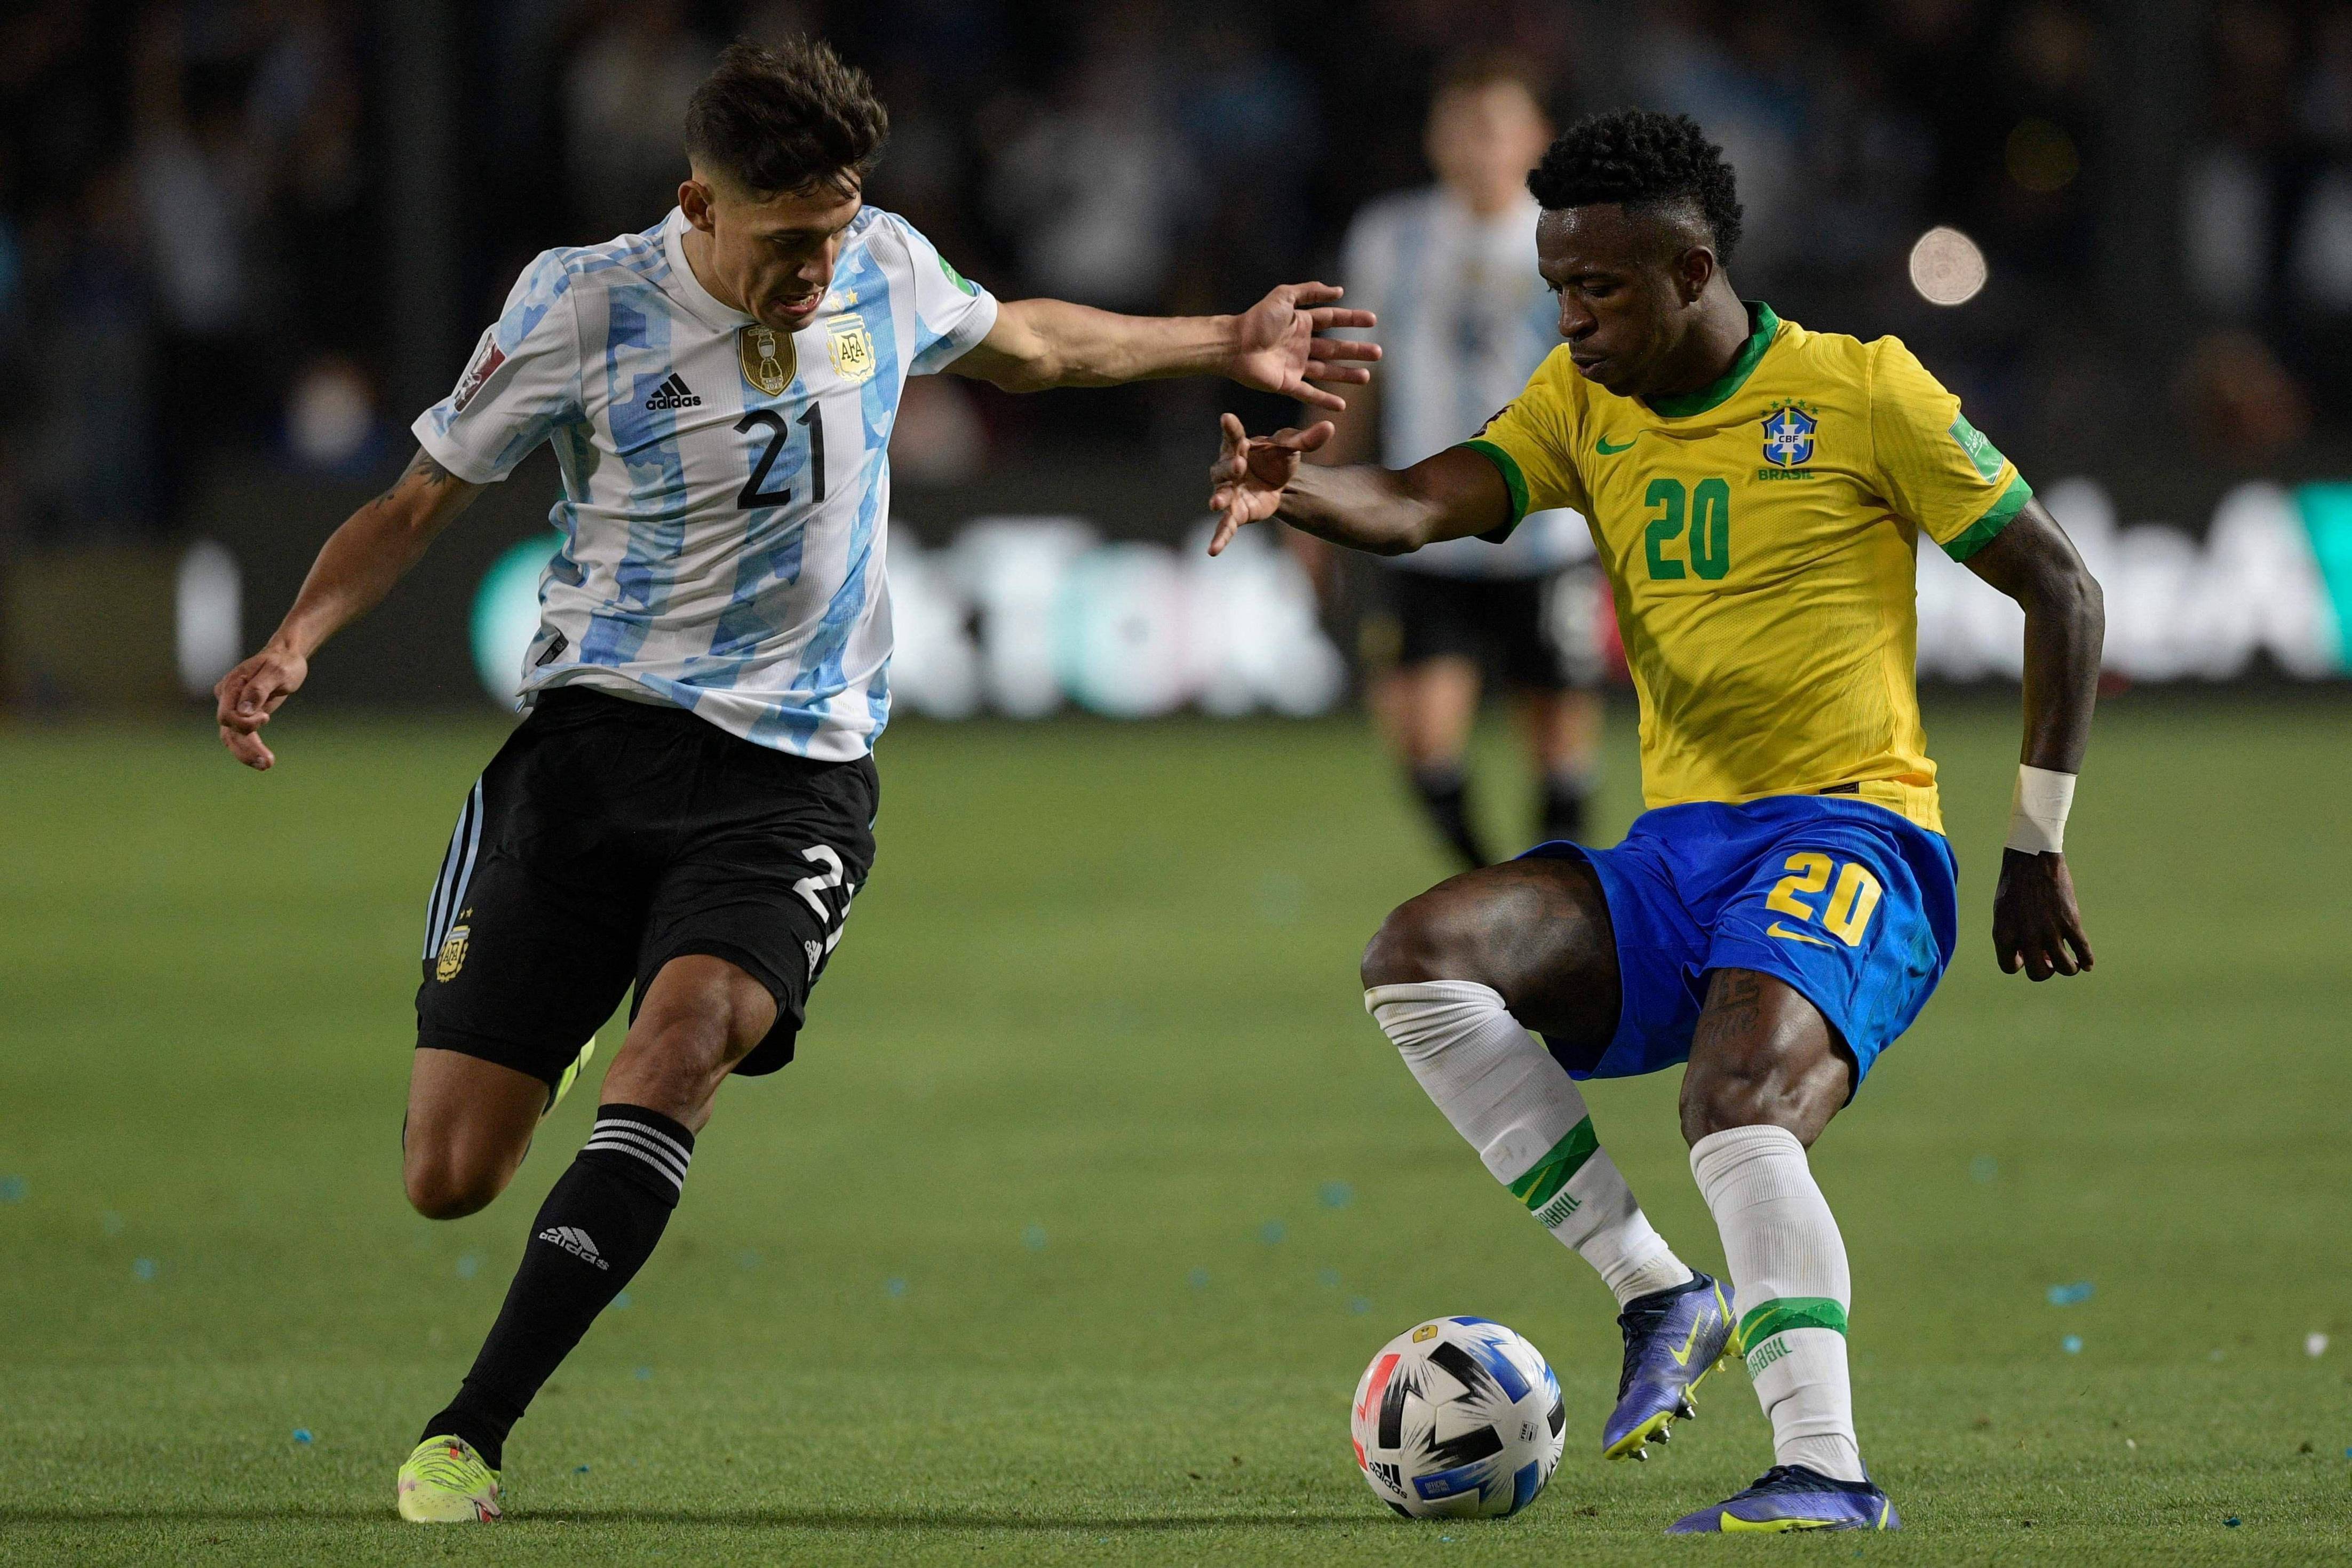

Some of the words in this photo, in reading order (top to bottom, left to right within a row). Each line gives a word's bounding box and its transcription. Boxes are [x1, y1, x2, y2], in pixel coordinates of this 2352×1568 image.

[645, 395, 702, 411] adidas
[733, 400, 825, 510] 21
[1778, 435, 1799, 443] CBF
[1758, 467, 1815, 481] BRASIL
[1644, 477, 1730, 580] 20
[1765, 851, 1883, 947] 20
[538, 1232, 609, 1271] adidas
[1369, 1462, 1408, 1499] adidas
